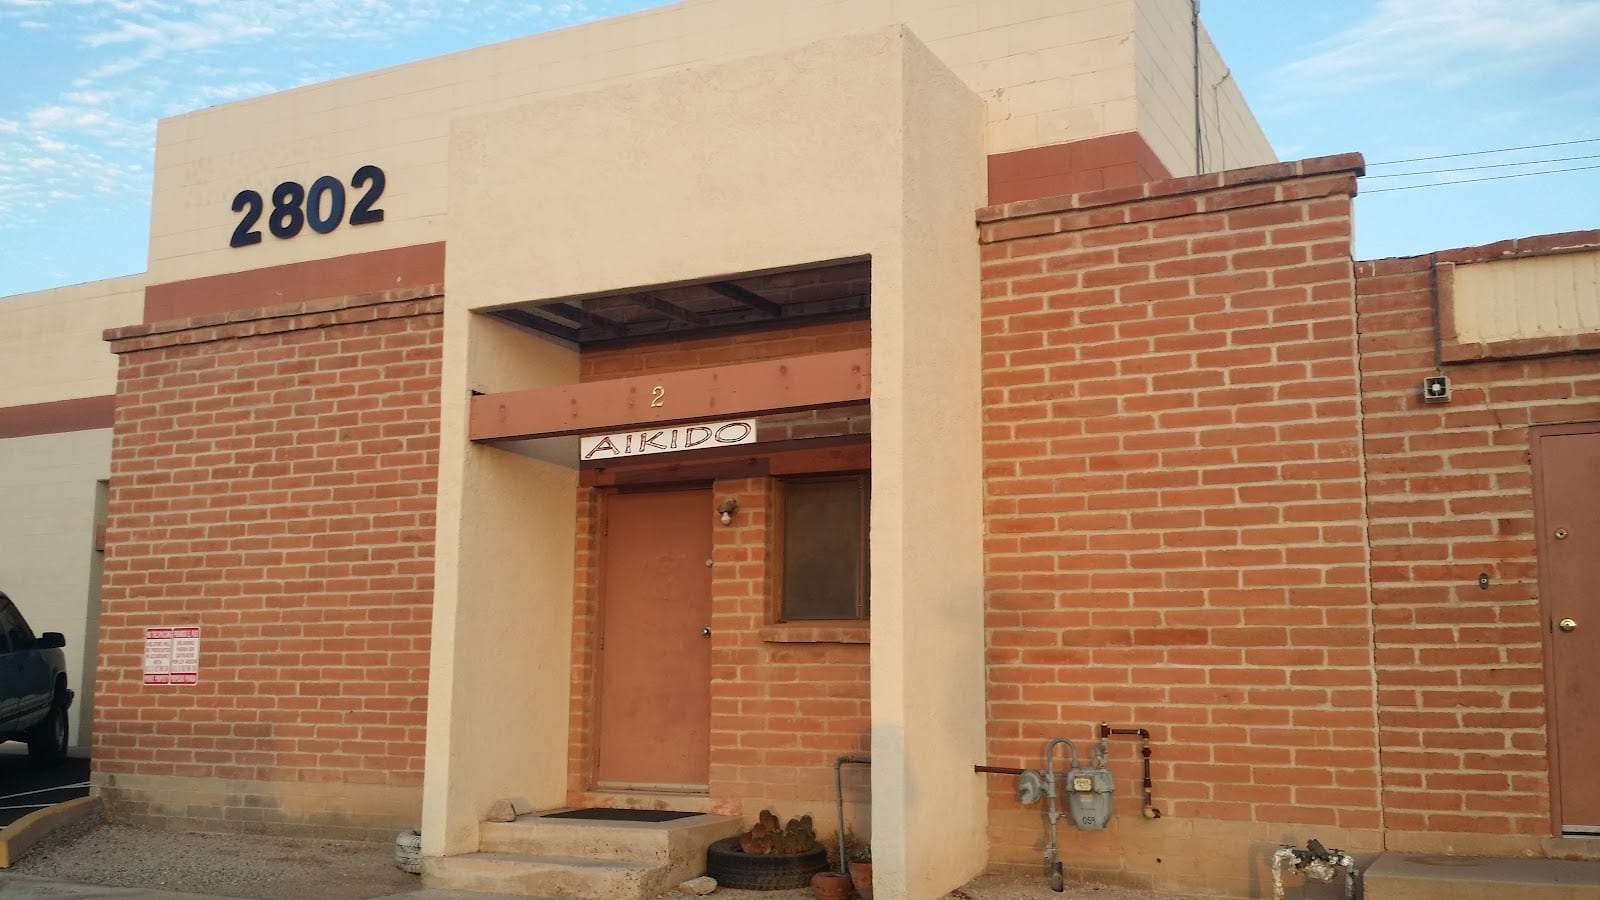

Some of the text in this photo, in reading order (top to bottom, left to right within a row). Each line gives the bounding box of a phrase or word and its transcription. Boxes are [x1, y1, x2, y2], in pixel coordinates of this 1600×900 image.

[230, 165, 385, 248] 2802
[650, 386, 665, 408] 2
[585, 422, 752, 459] AIKIDO
